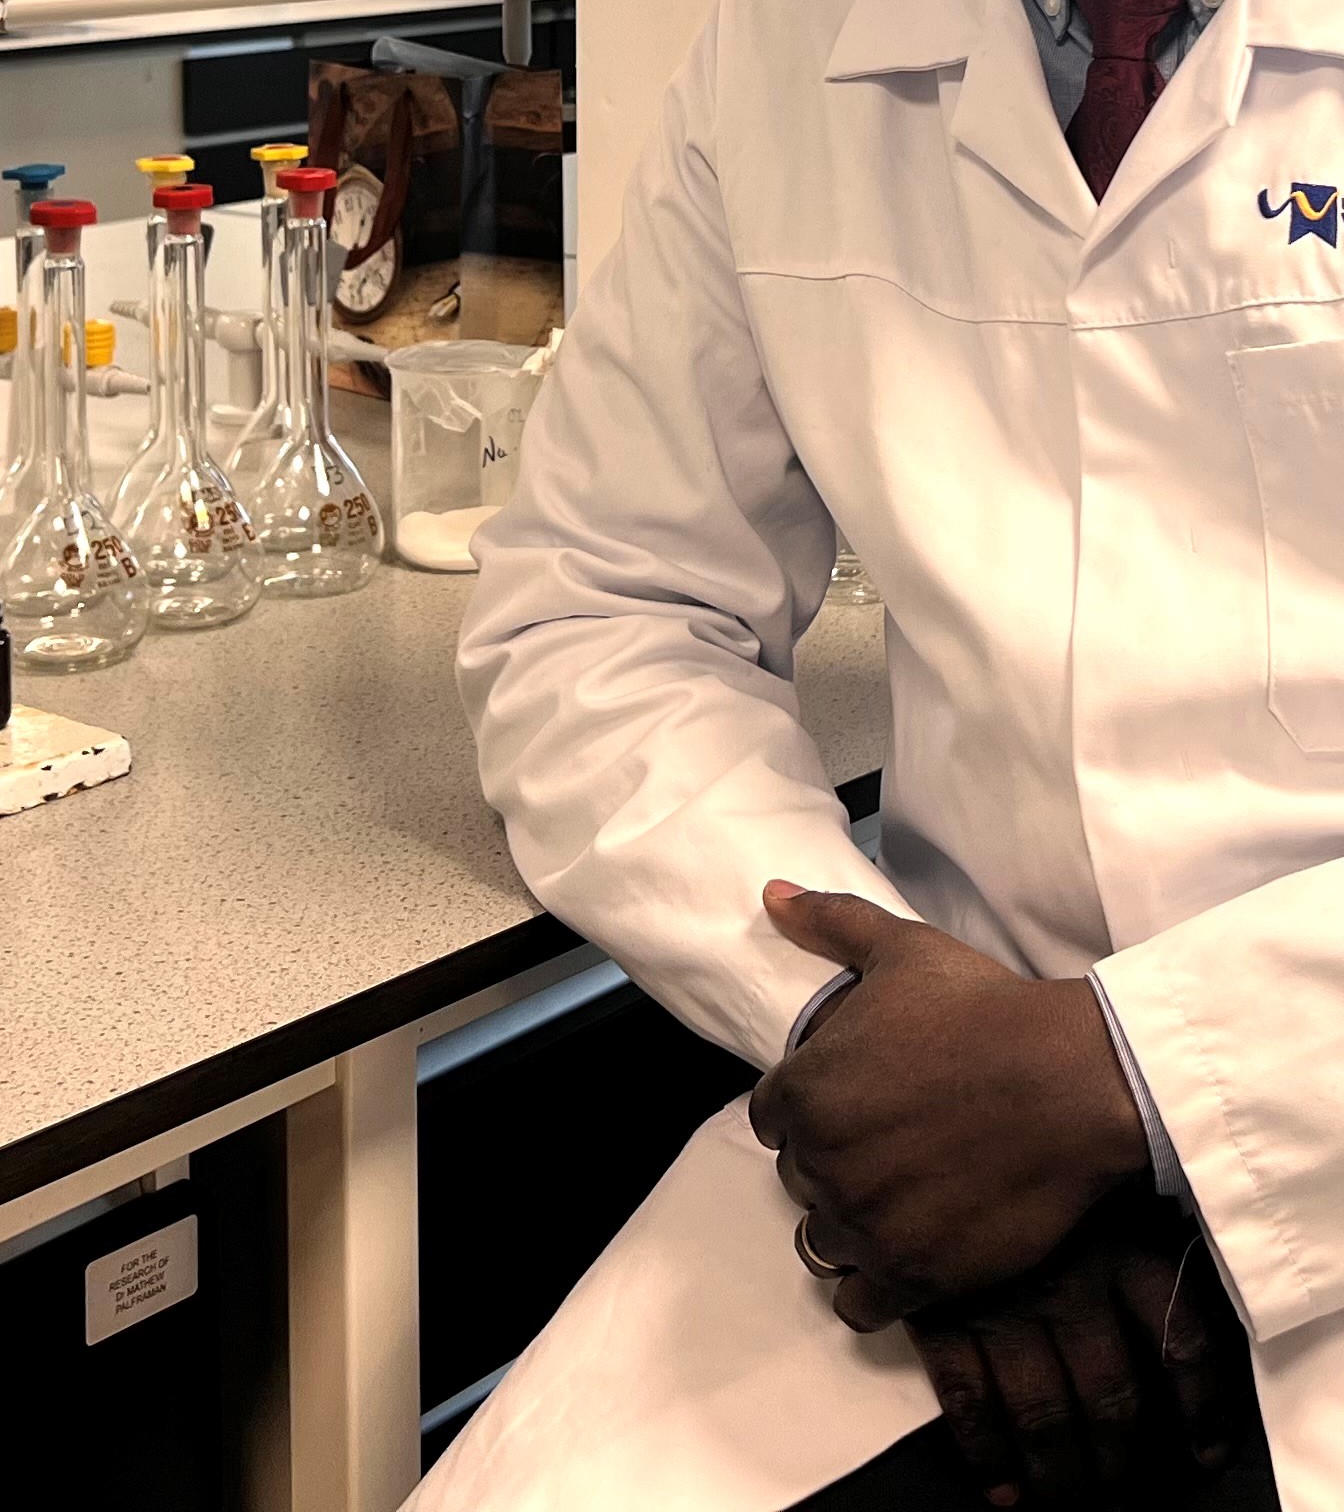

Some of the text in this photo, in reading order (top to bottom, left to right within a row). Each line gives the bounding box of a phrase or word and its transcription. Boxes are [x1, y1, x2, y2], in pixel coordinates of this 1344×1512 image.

[120, 557, 137, 579] B
[121, 1249, 158, 1273] FOR THE
[108, 1264, 157, 1292] RESEARCH
